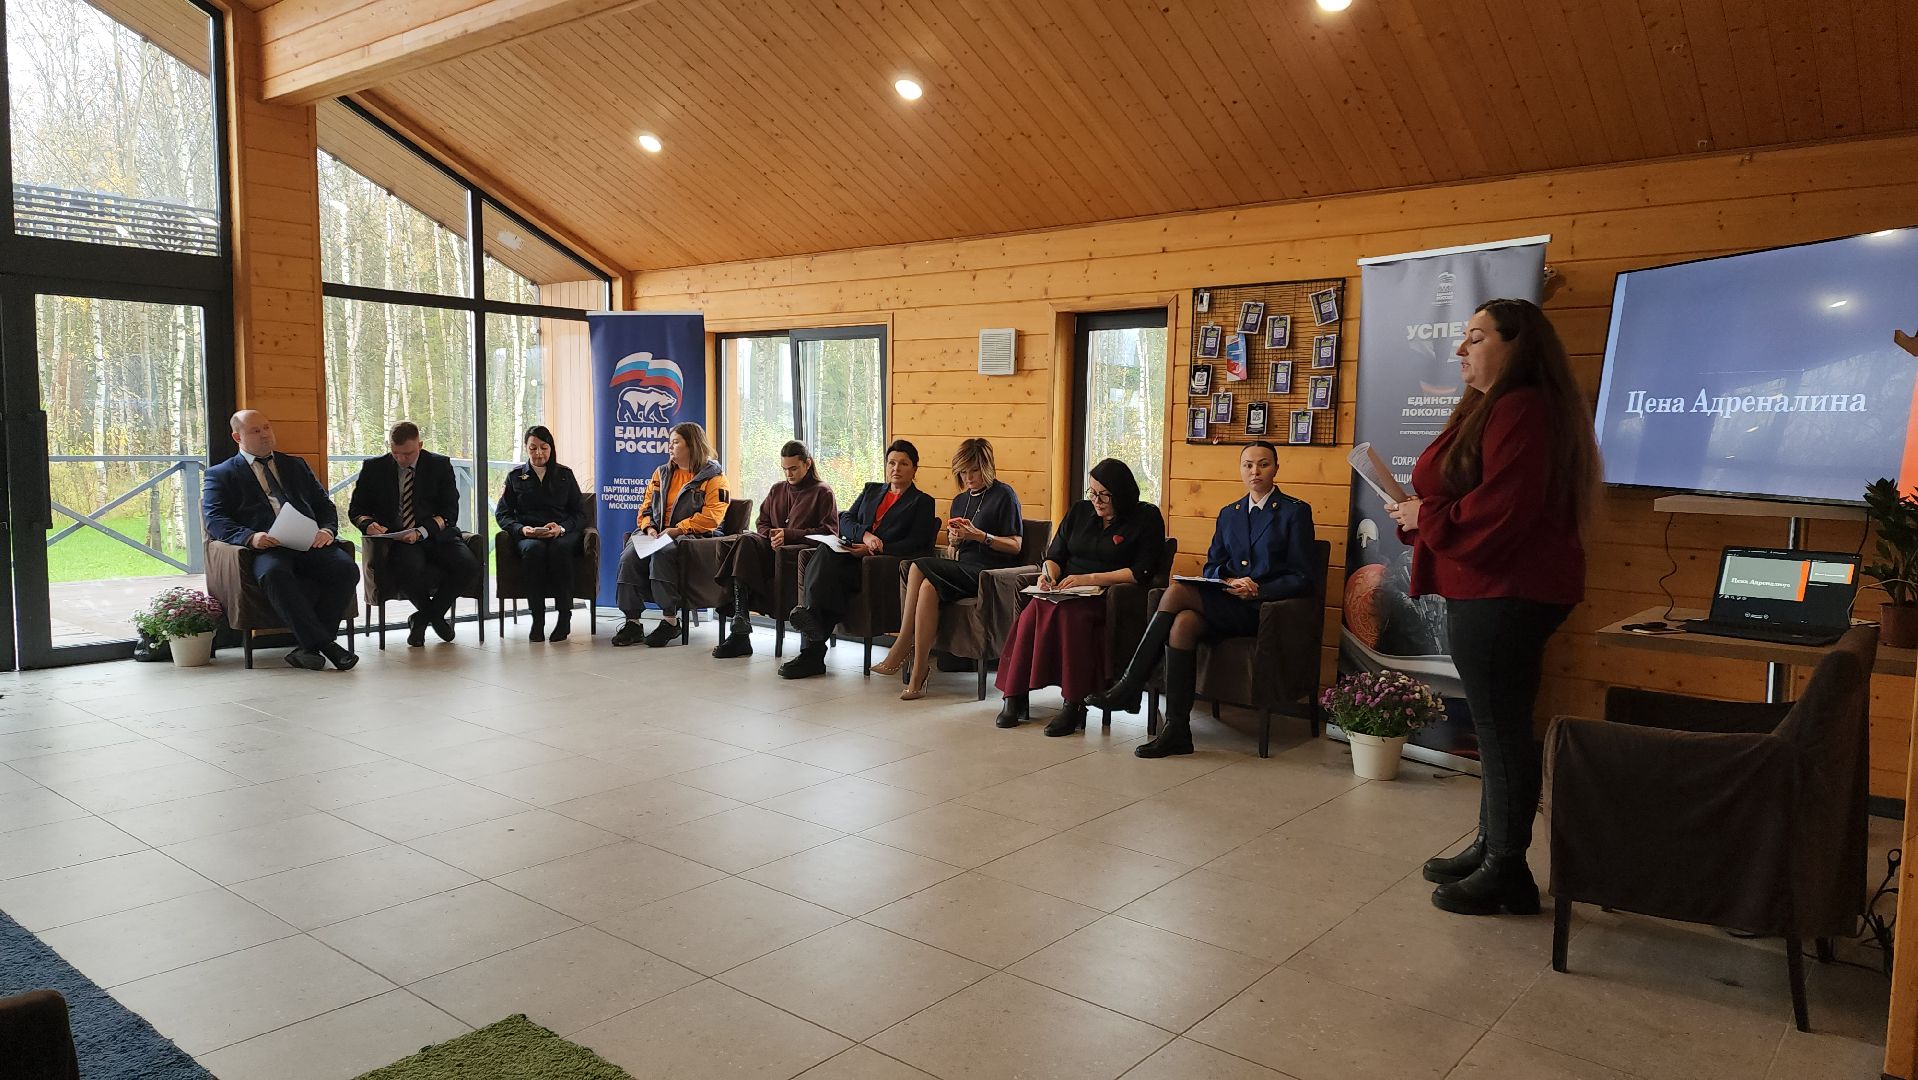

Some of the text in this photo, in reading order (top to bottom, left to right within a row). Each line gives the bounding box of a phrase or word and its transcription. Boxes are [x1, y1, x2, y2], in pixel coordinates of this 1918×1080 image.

[1407, 321, 1468, 340] УСПЕ
[1407, 396, 1463, 406] ЕДИНСТВ
[1624, 388, 1868, 418] Цена Адреналина
[1402, 408, 1455, 417] ПОКОЛЕН
[614, 426, 672, 439] ЕДИНА
[615, 440, 670, 454] РОССИ
[1392, 455, 1419, 466] СОХРА
[603, 485, 630, 493] ПАРТИИ
[608, 502, 642, 510] МОСКОВС
